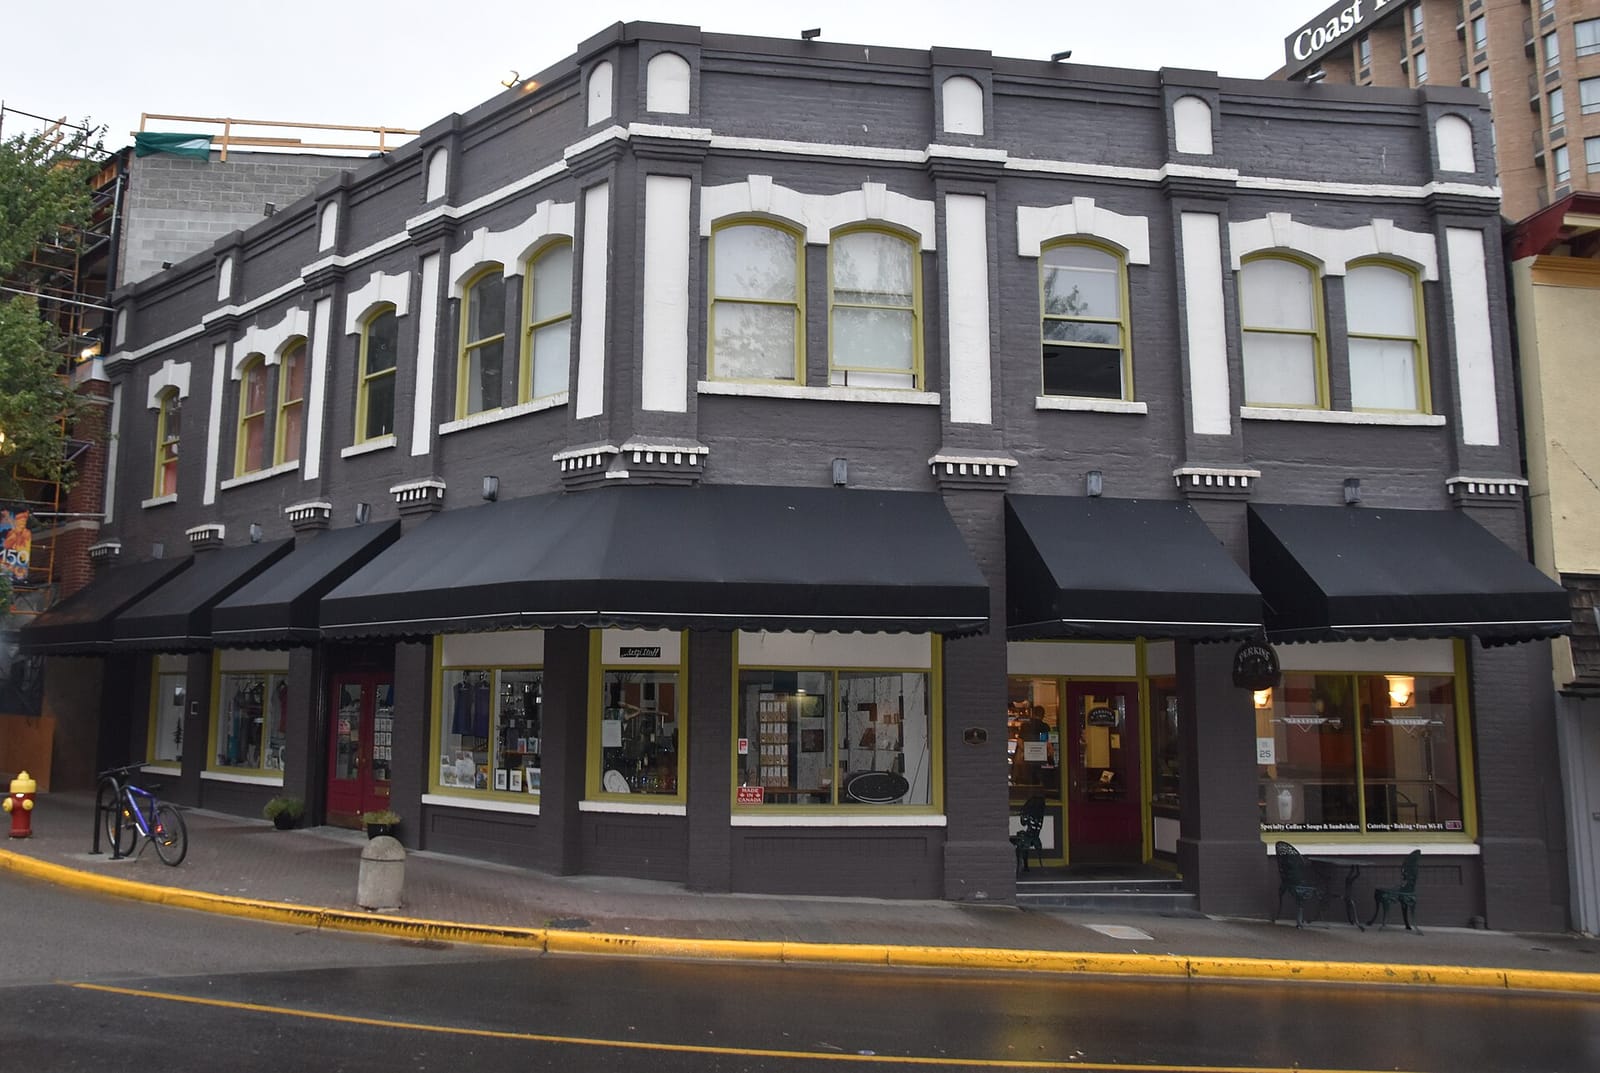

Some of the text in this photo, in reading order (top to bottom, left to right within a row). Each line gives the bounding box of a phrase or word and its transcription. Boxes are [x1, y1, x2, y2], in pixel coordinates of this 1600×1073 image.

[1293, 0, 1364, 61] Coast
[0, 549, 30, 566] 150
[1259, 750, 1271, 758] 25
[1260, 823, 1285, 831] Specialty
